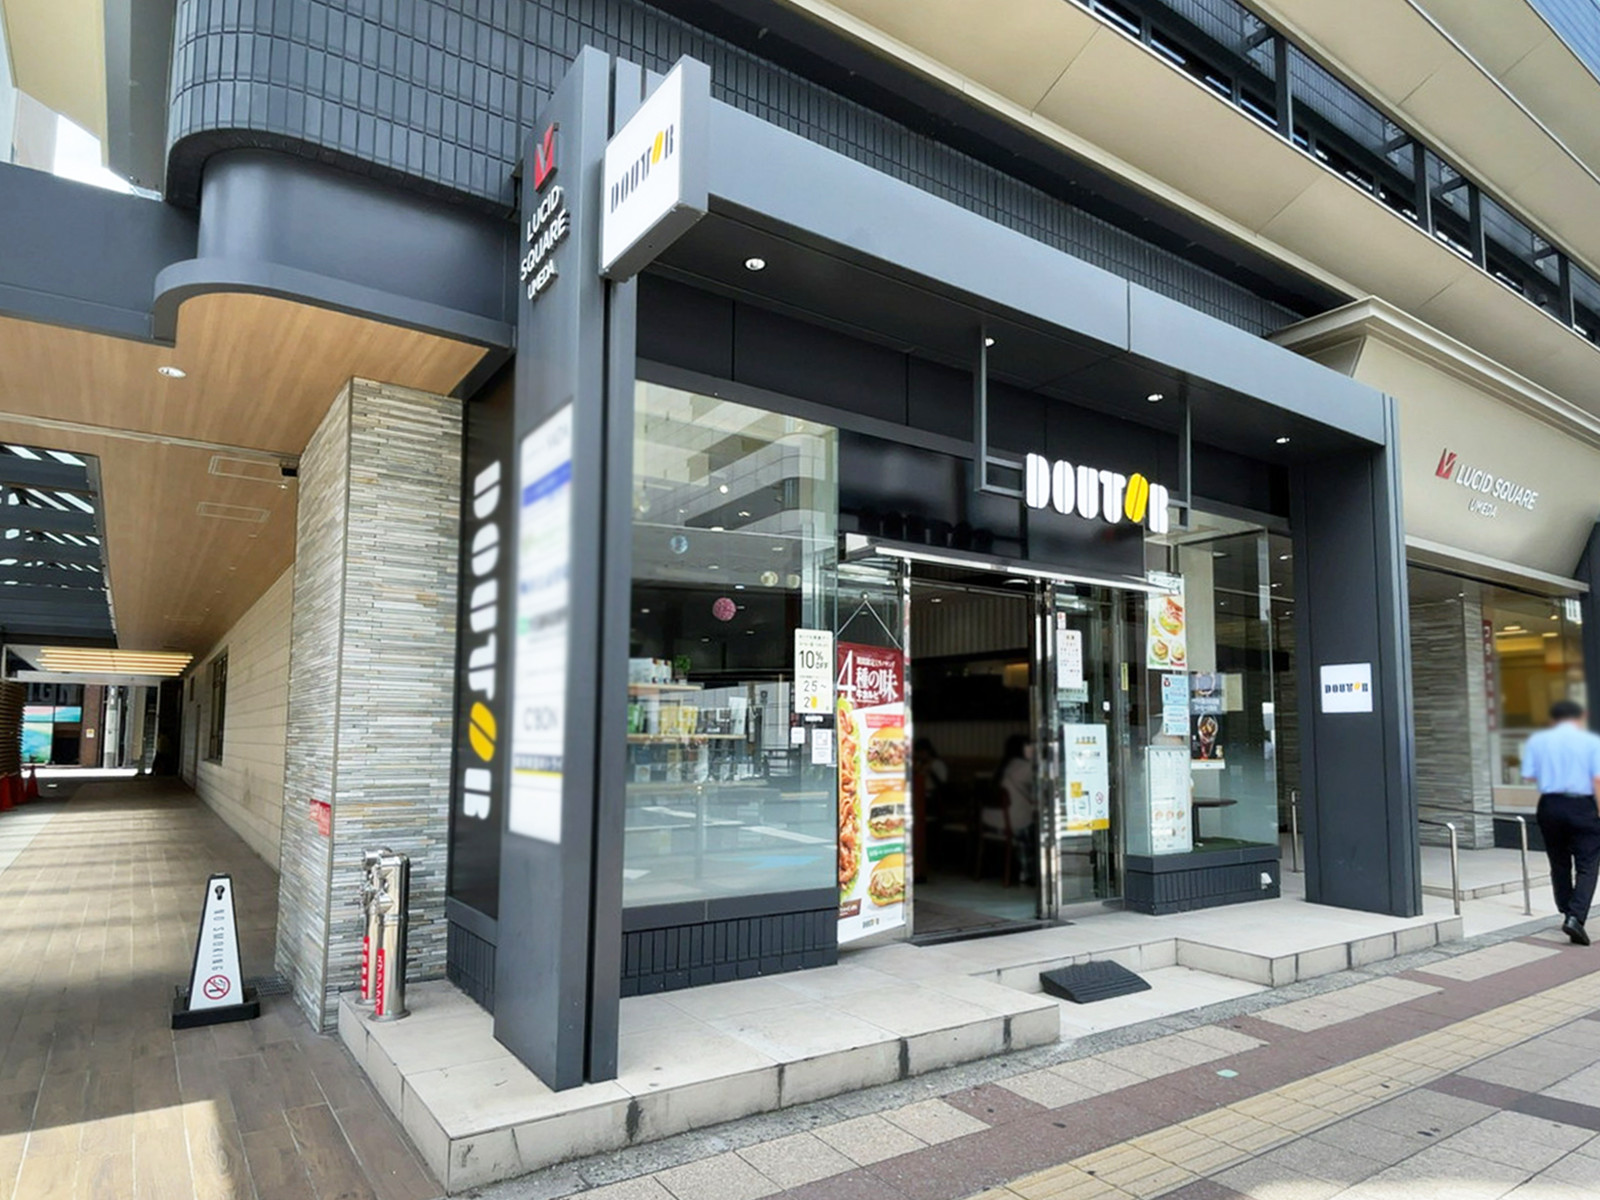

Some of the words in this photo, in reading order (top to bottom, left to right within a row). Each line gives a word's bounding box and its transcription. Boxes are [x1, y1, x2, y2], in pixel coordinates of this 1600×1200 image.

[610, 124, 674, 214] DOUTOR
[527, 184, 564, 242] LUCID
[520, 208, 568, 280] SQUARE
[527, 259, 557, 300] UMEDA
[1026, 453, 1169, 534] DOUTOR
[1455, 464, 1493, 494] LUCID
[1492, 478, 1539, 510] SQUARE
[1468, 498, 1498, 518] UMEDA
[463, 461, 501, 820] DOUTOR
[1324, 681, 1369, 694] DOUTOR
[213, 908, 225, 921] NO
[211, 926, 225, 971] SMOKING
